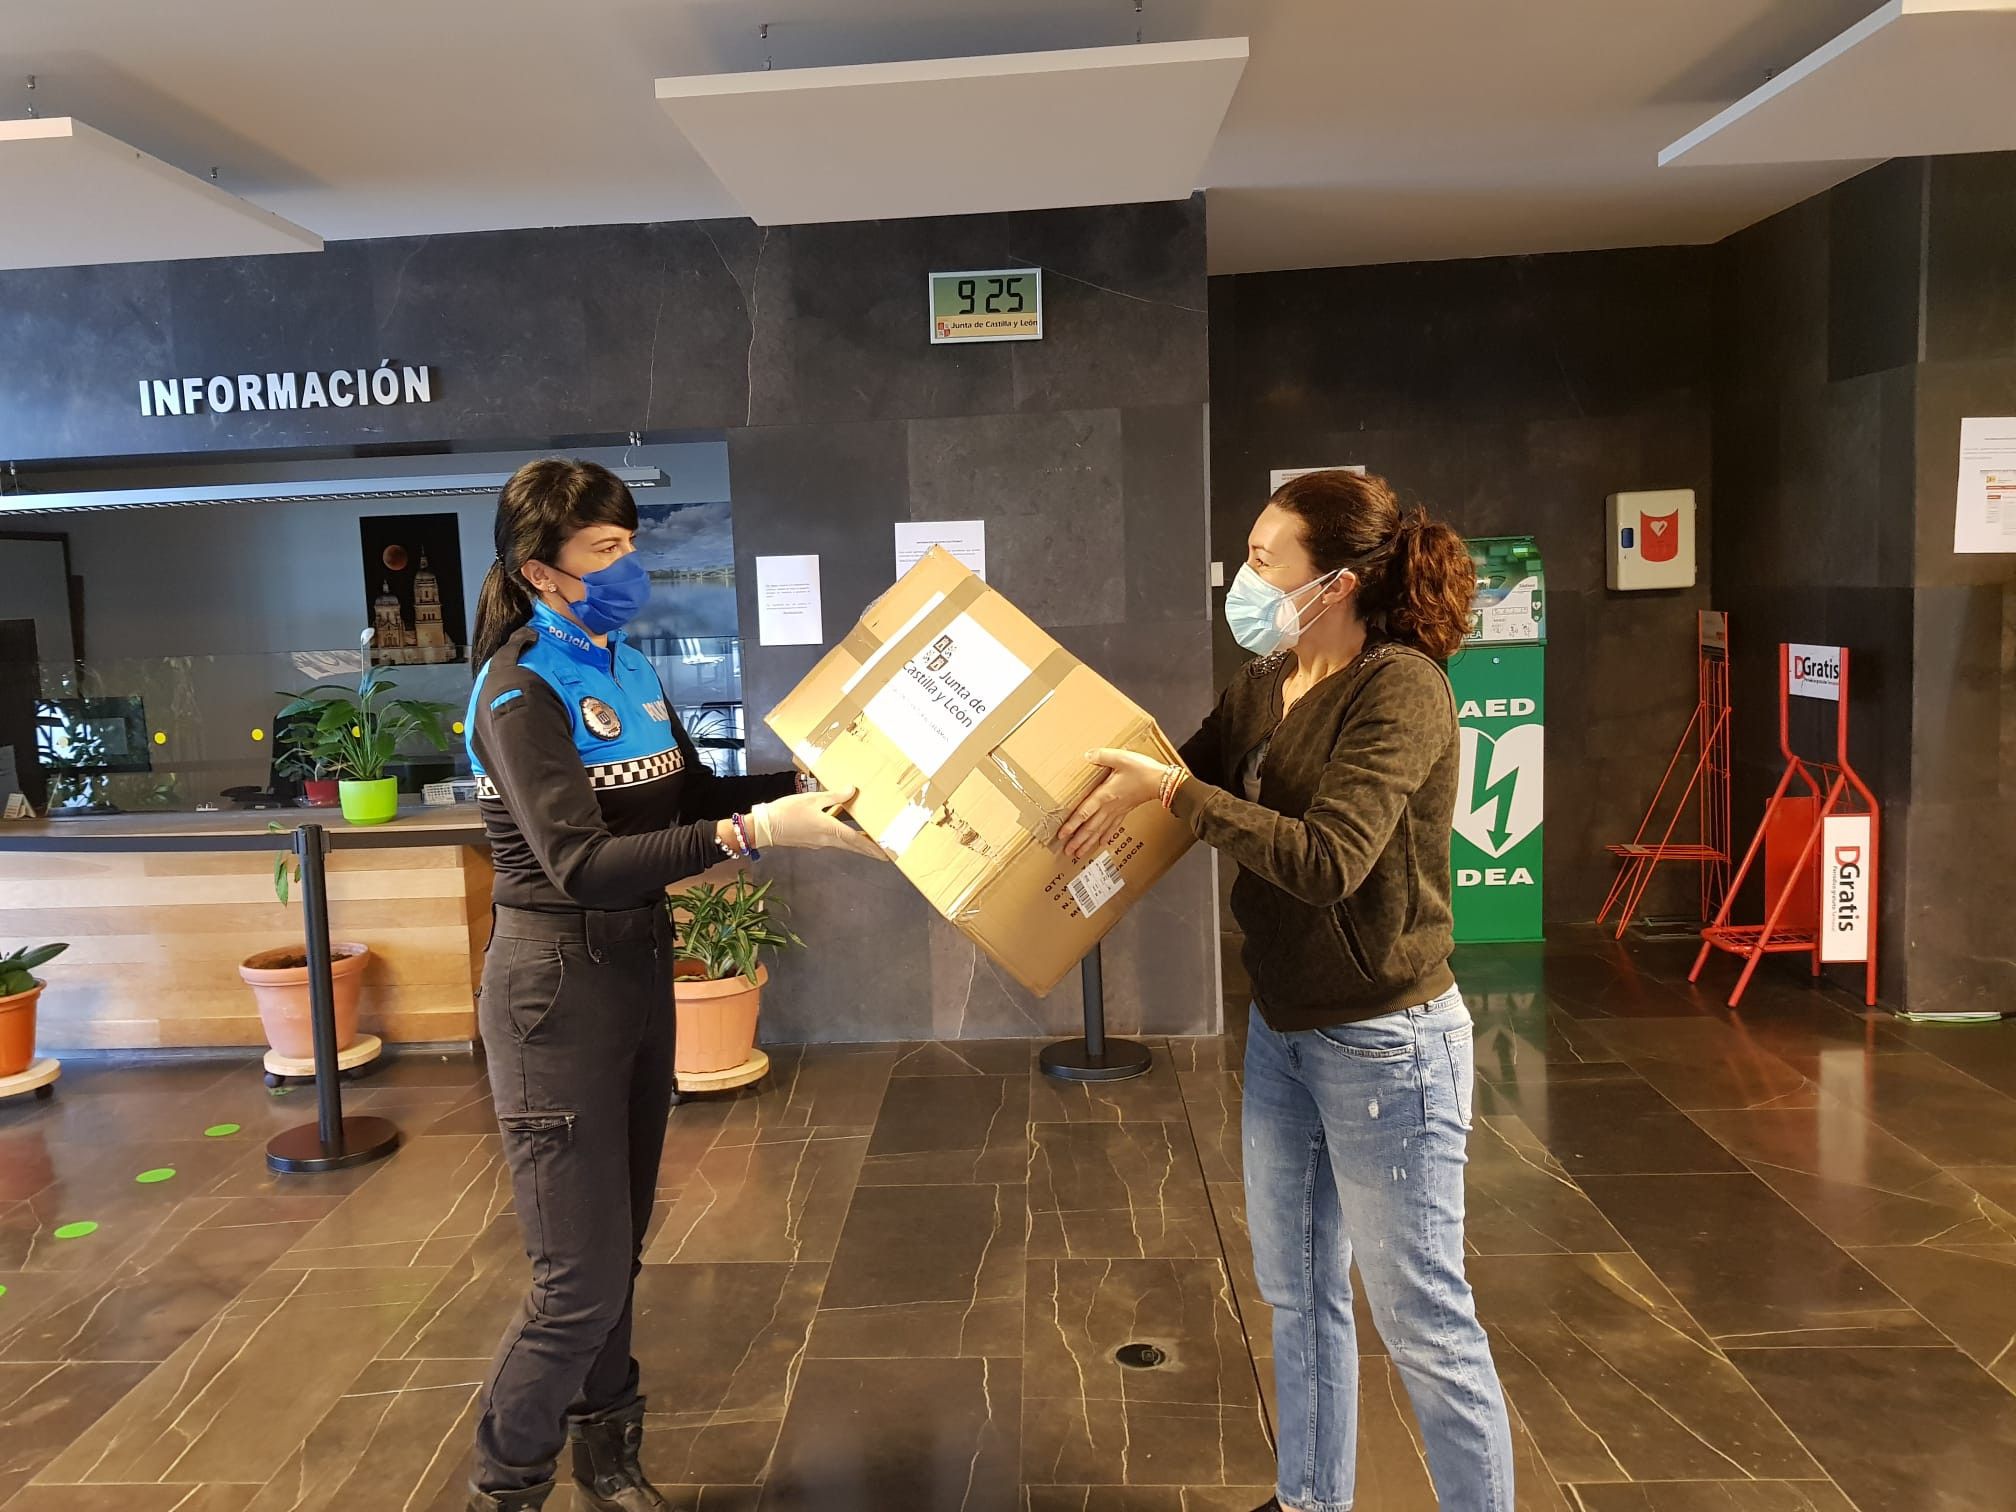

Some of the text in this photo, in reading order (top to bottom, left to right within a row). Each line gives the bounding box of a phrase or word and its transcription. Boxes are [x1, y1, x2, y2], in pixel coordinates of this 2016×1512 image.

[951, 321, 972, 329] Junta
[985, 320, 1011, 328] Castilla
[1020, 319, 1038, 327] León
[138, 358, 431, 416] INFORMACIÓN
[549, 625, 590, 652] POLICÍA
[1794, 655, 1839, 680] DGratis
[902, 659, 938, 695] Castilla
[932, 692, 946, 703] y
[943, 697, 973, 728] León
[939, 671, 971, 701] Junta
[968, 697, 986, 715] de
[1457, 698, 1536, 719] AED
[1456, 867, 1535, 886] DEA
[1835, 846, 1861, 932] DGratis
